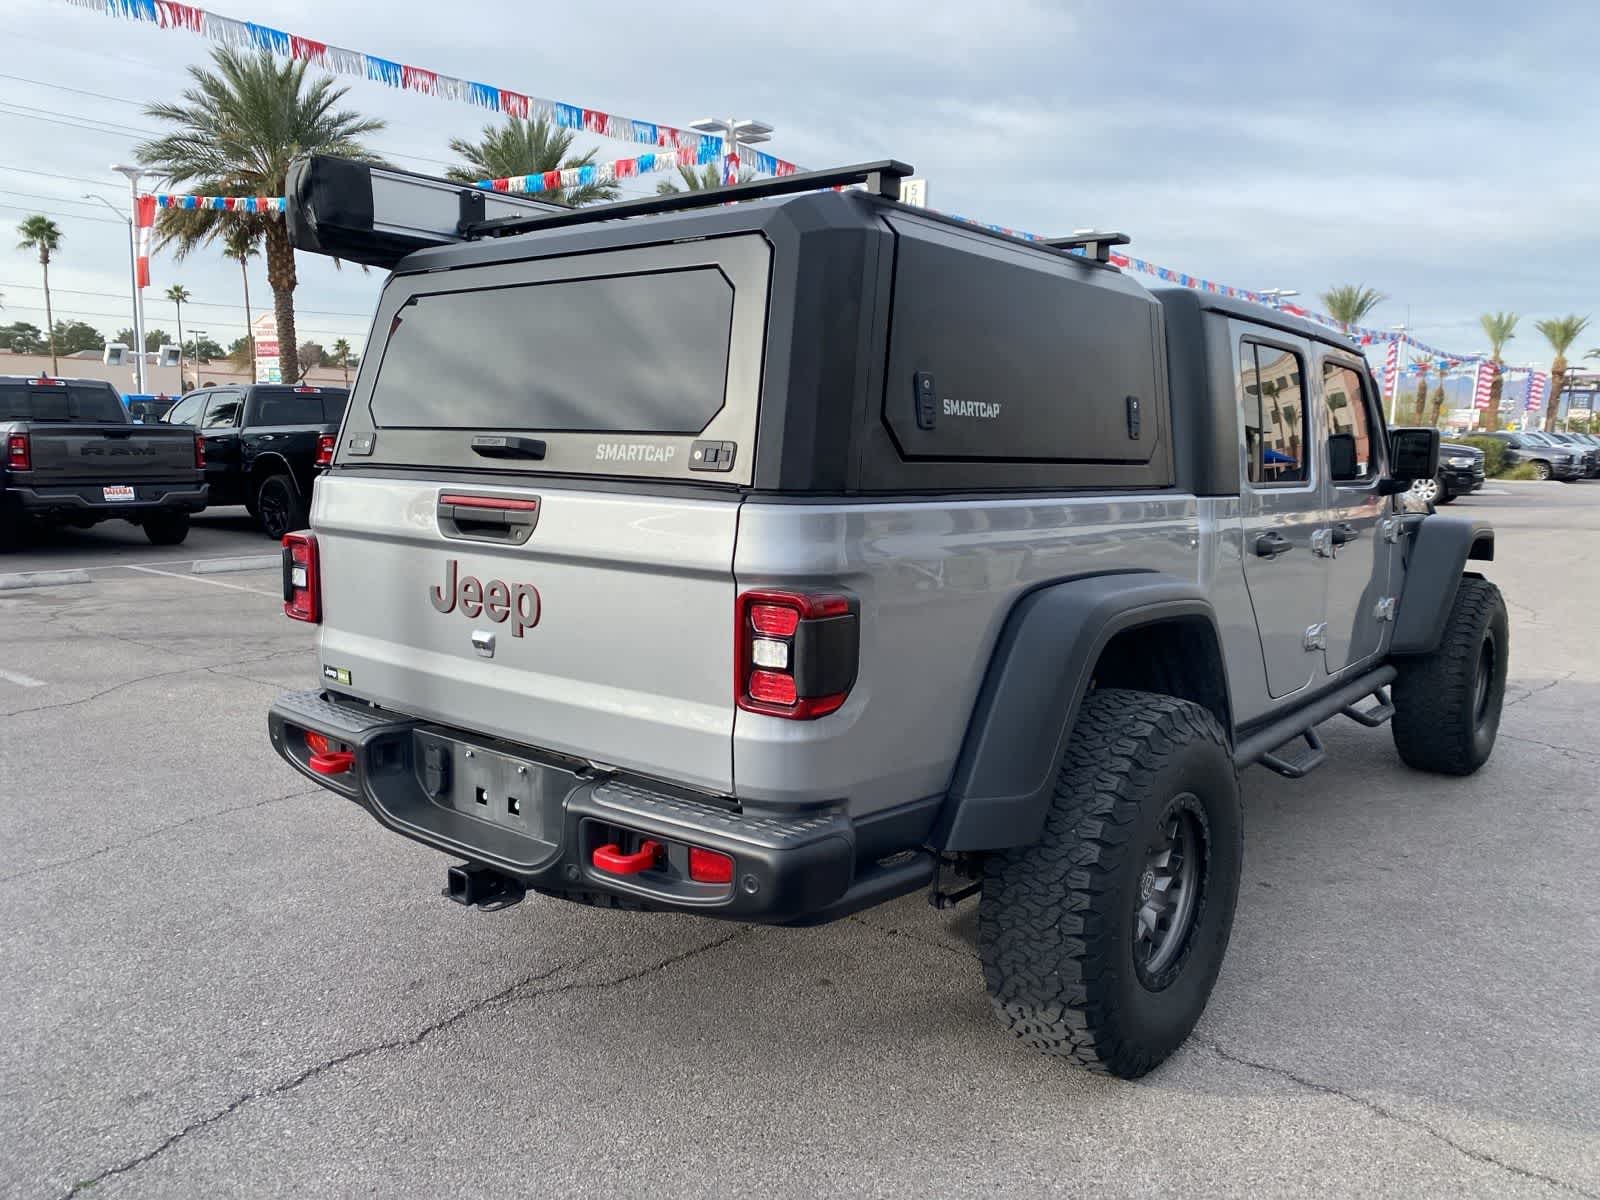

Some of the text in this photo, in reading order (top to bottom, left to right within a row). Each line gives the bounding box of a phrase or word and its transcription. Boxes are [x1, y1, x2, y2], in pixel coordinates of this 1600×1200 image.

[943, 398, 1000, 419] SMARTCAP
[595, 443, 675, 462] SMARTCAP
[430, 559, 541, 638] Jeep
